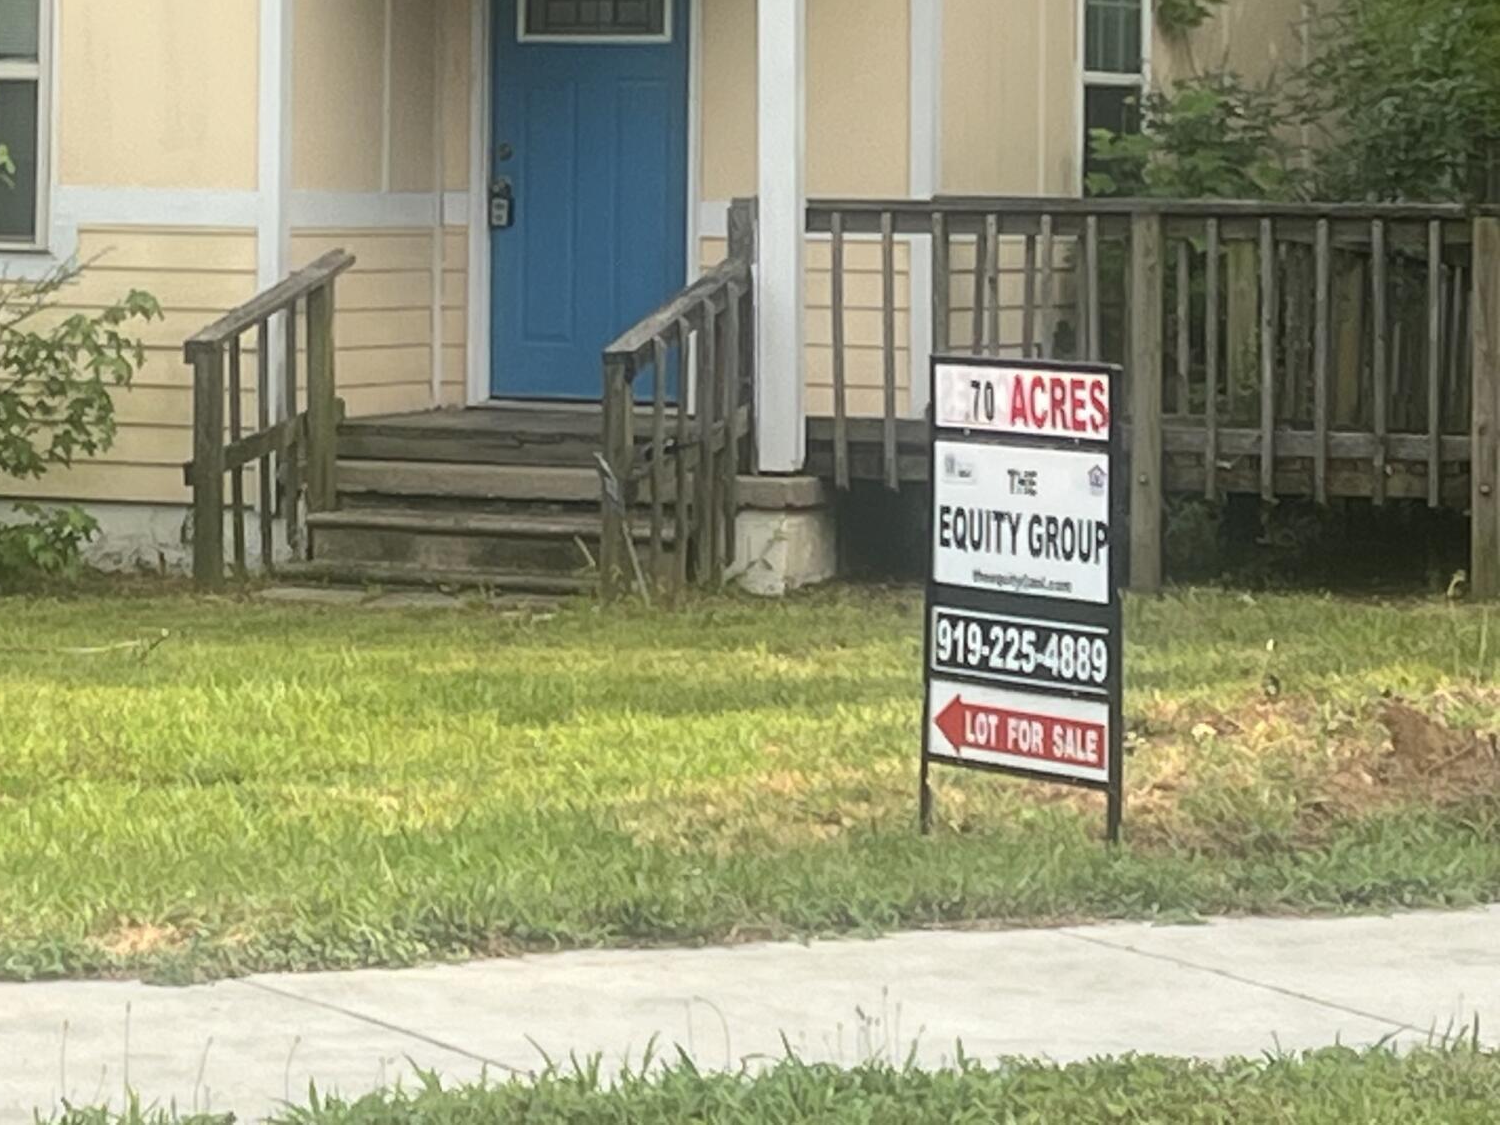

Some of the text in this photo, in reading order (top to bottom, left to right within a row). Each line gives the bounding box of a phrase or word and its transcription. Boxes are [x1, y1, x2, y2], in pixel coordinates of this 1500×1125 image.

[1010, 374, 1110, 434] ACRES
[939, 505, 1109, 565] EQUITY GROUP
[937, 618, 1108, 683] 919-225-4889
[965, 710, 1099, 763] LOT FOR SALE
